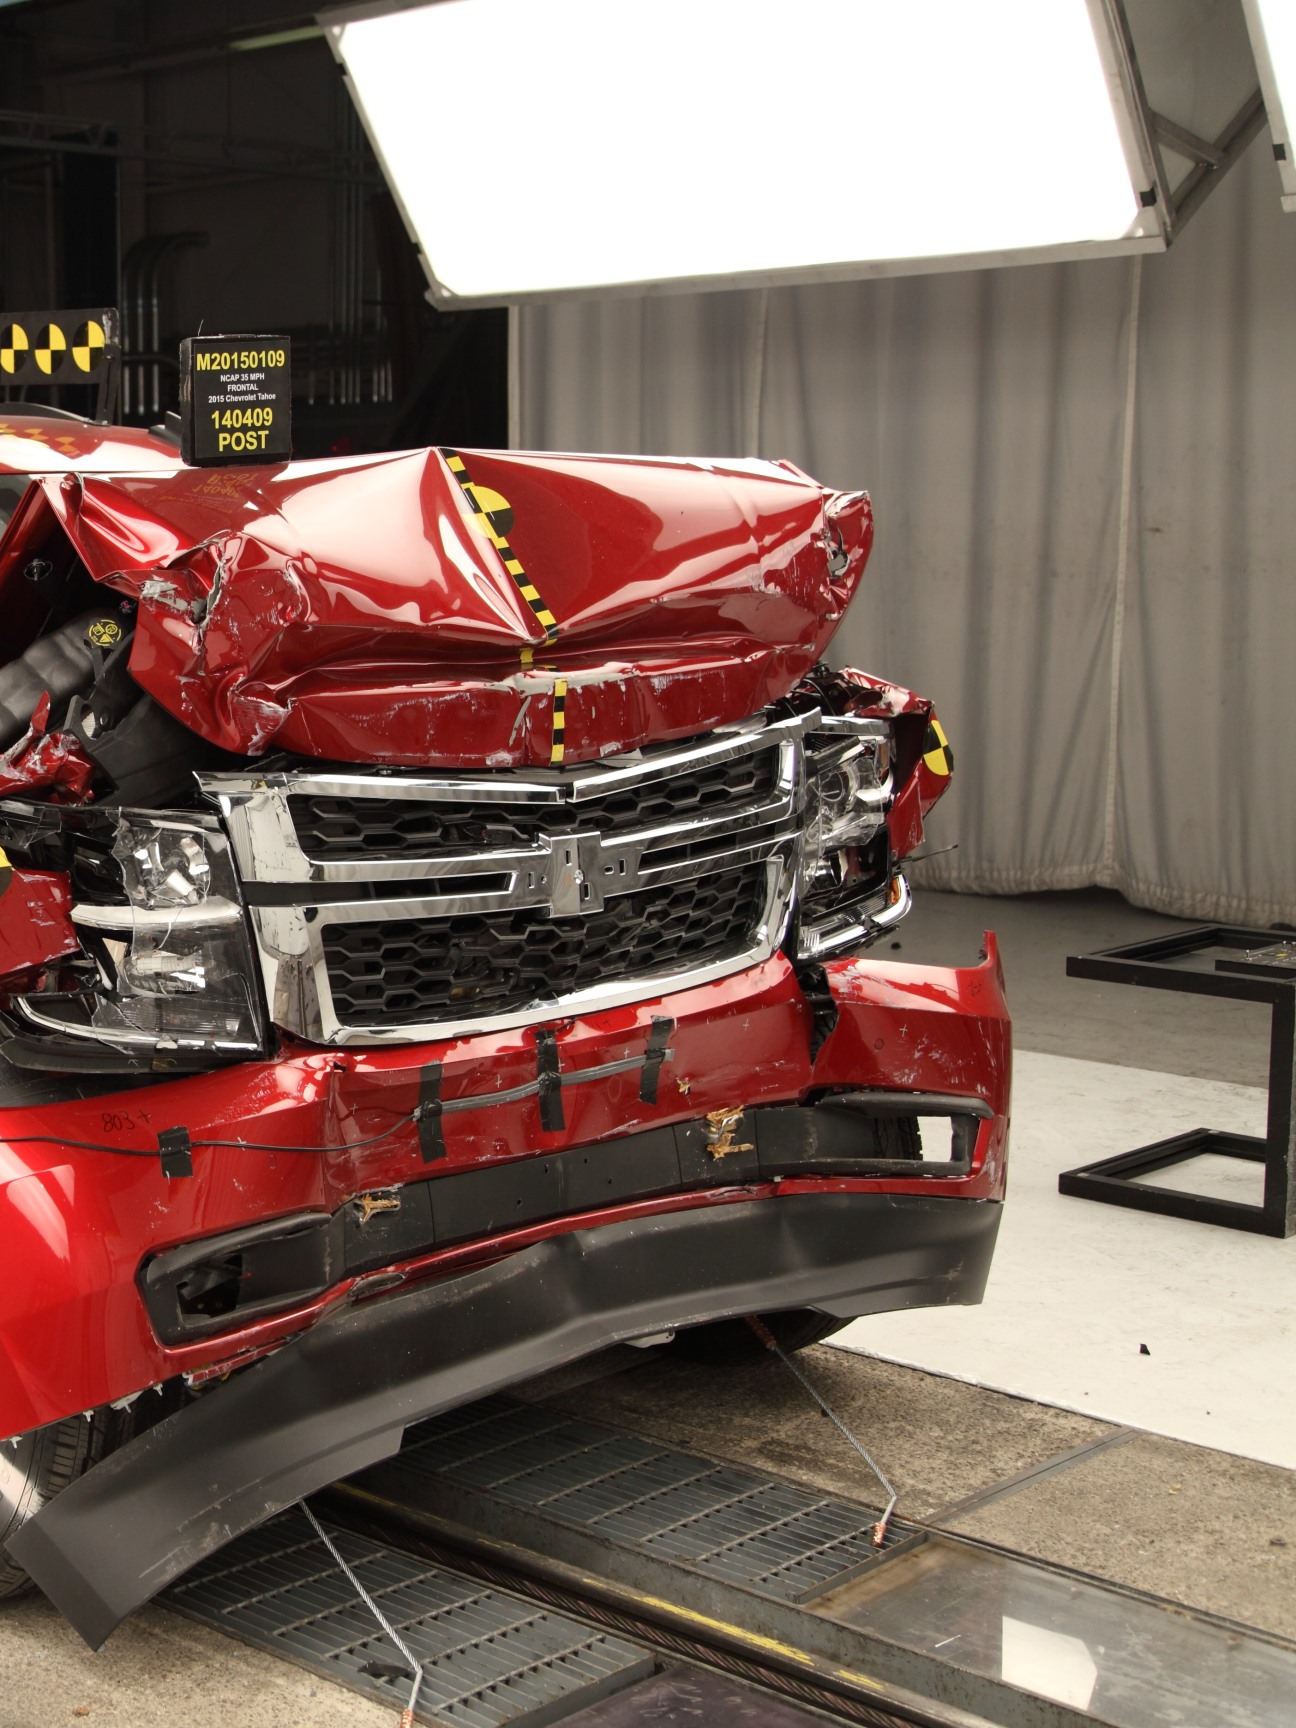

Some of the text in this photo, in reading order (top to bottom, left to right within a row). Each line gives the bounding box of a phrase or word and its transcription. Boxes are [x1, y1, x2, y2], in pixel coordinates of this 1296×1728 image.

[196, 350, 285, 371] M20150109
[220, 373, 265, 382] NCAP 35 MPH
[227, 383, 259, 392] FRONTAL
[208, 393, 277, 403] 2015 Chevrolet Tahoe
[211, 407, 273, 429] 140409
[218, 430, 269, 452] POST
